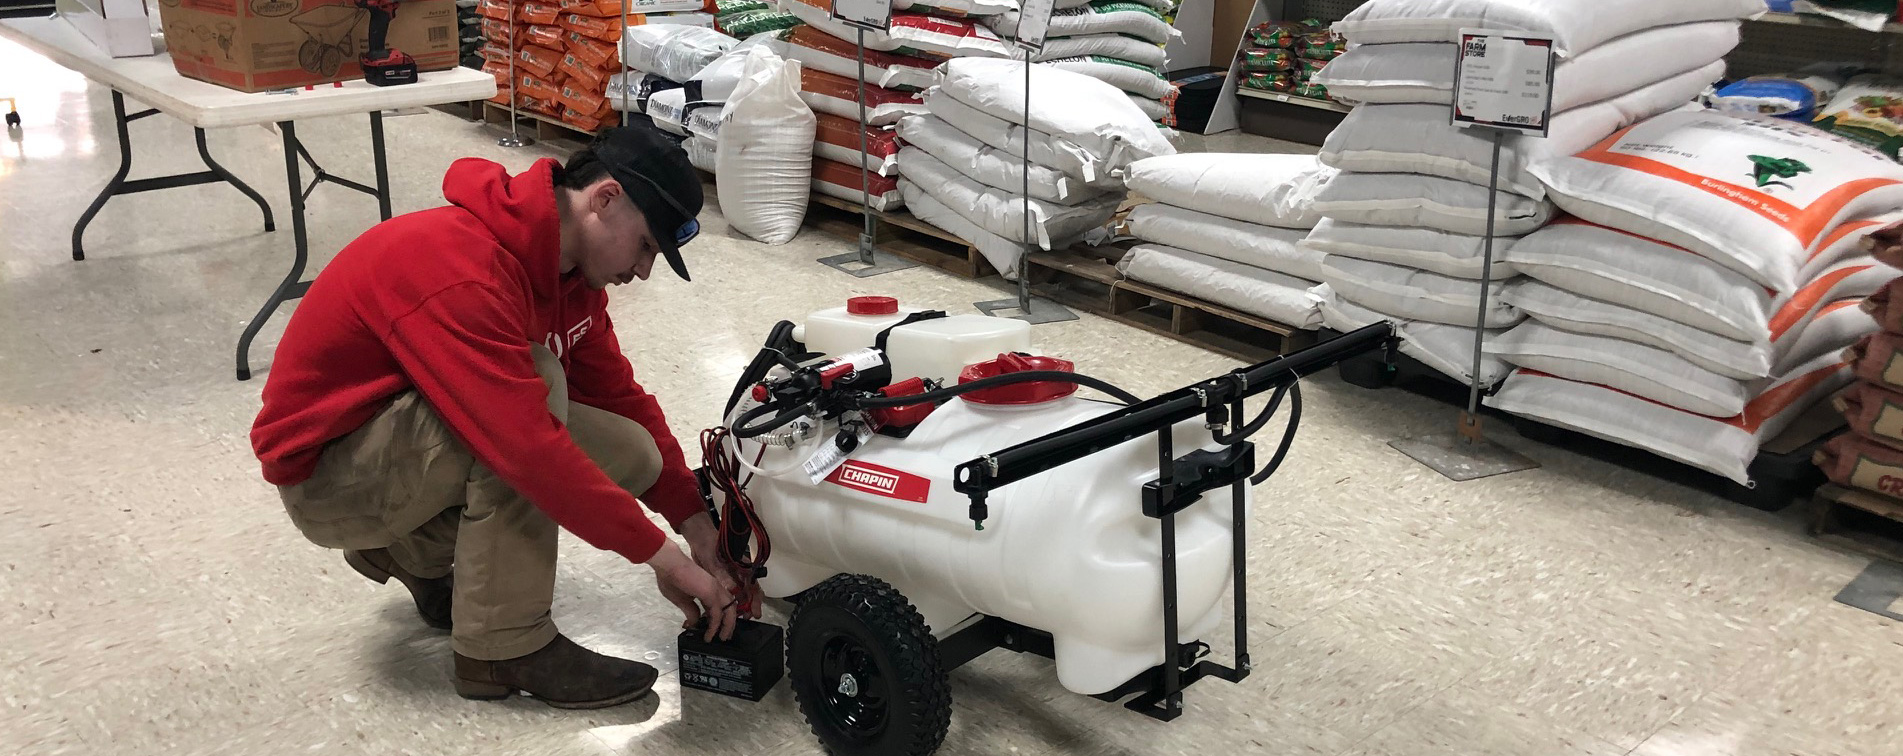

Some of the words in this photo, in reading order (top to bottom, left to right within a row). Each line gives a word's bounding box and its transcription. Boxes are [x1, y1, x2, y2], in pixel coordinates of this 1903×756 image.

[1465, 42, 1487, 51] FARM
[1464, 50, 1486, 58] STORE
[1501, 113, 1530, 124] EverGRO
[1700, 177, 1759, 207] Burlingham
[1759, 202, 1790, 223] Seeds
[843, 469, 893, 489] CHAPIN
